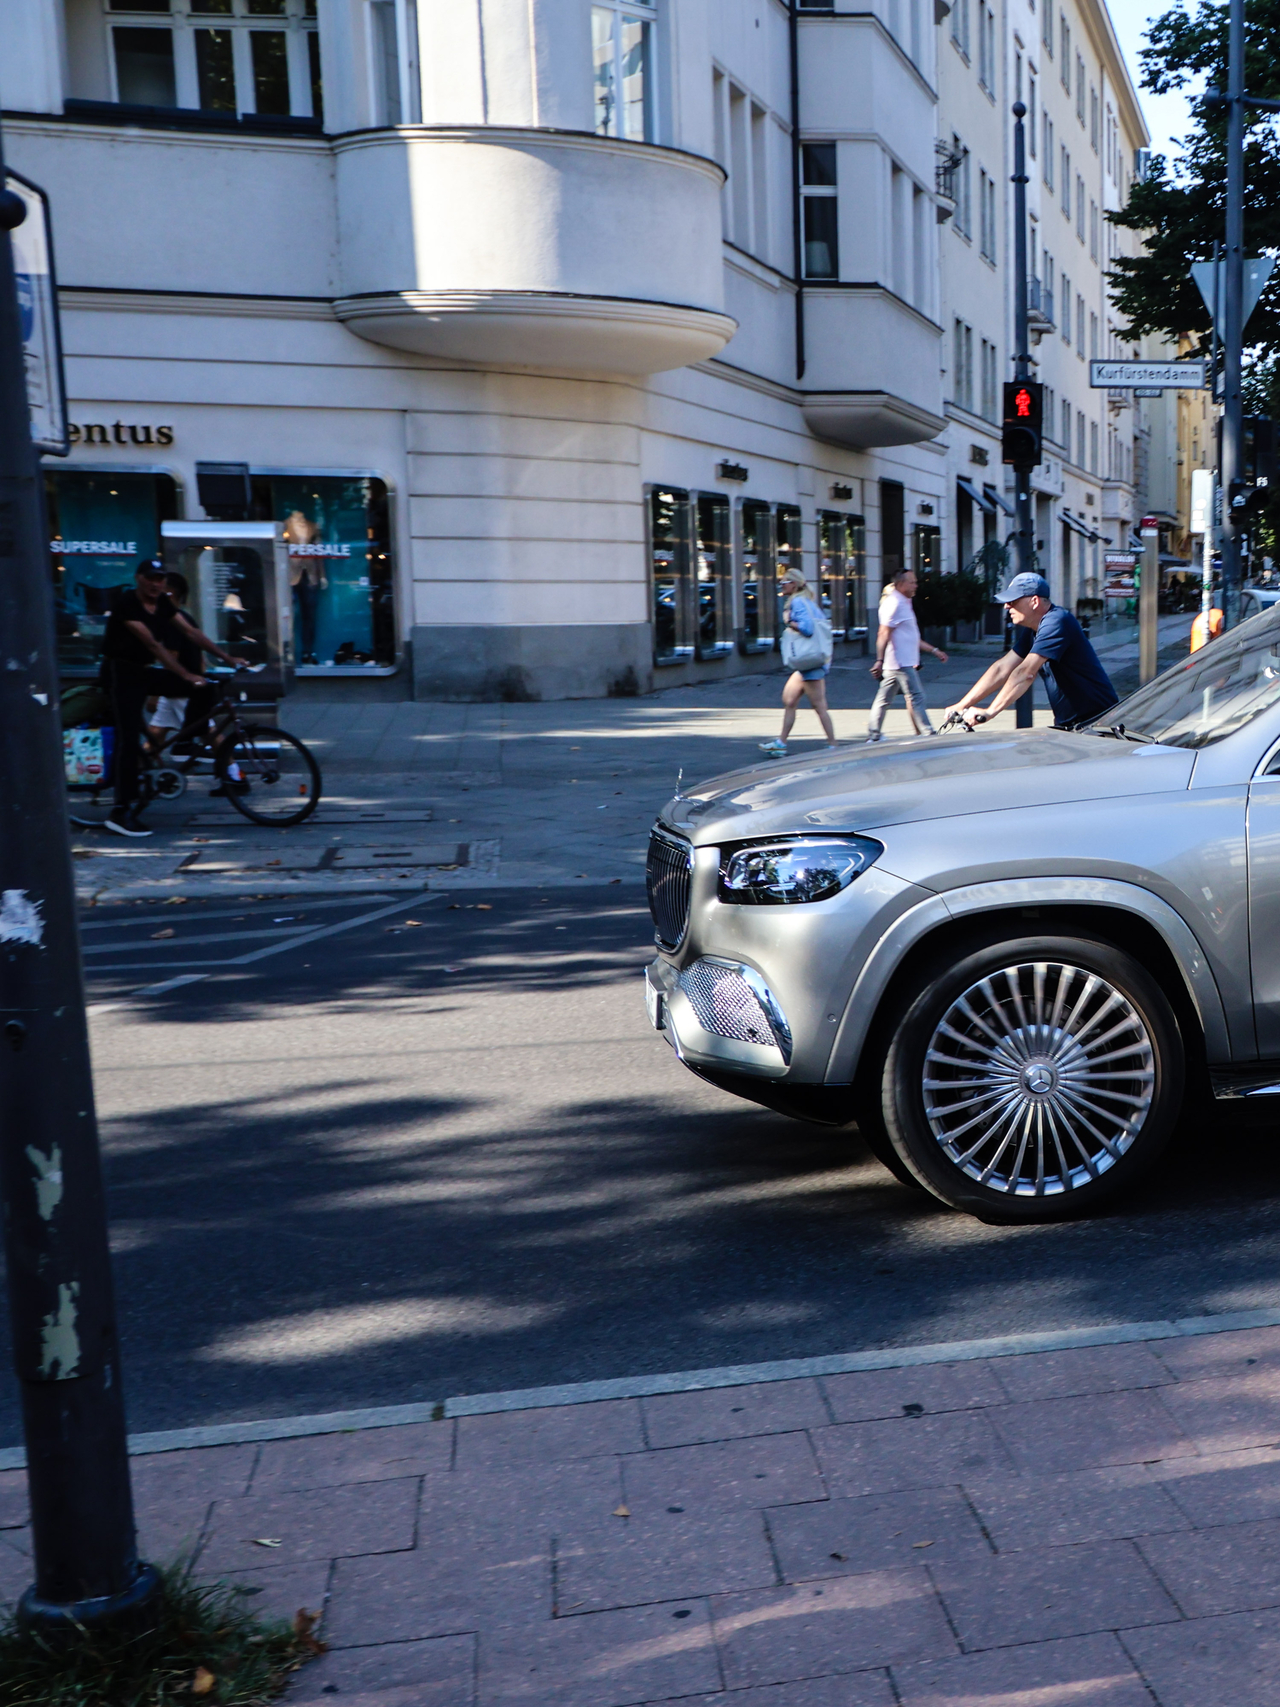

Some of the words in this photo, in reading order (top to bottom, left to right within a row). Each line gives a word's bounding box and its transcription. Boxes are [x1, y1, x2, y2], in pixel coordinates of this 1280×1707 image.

[1096, 365, 1200, 381] Kurfürstendamm
[49, 541, 138, 554] SUPERSALE
[289, 543, 350, 556] PERSALE
